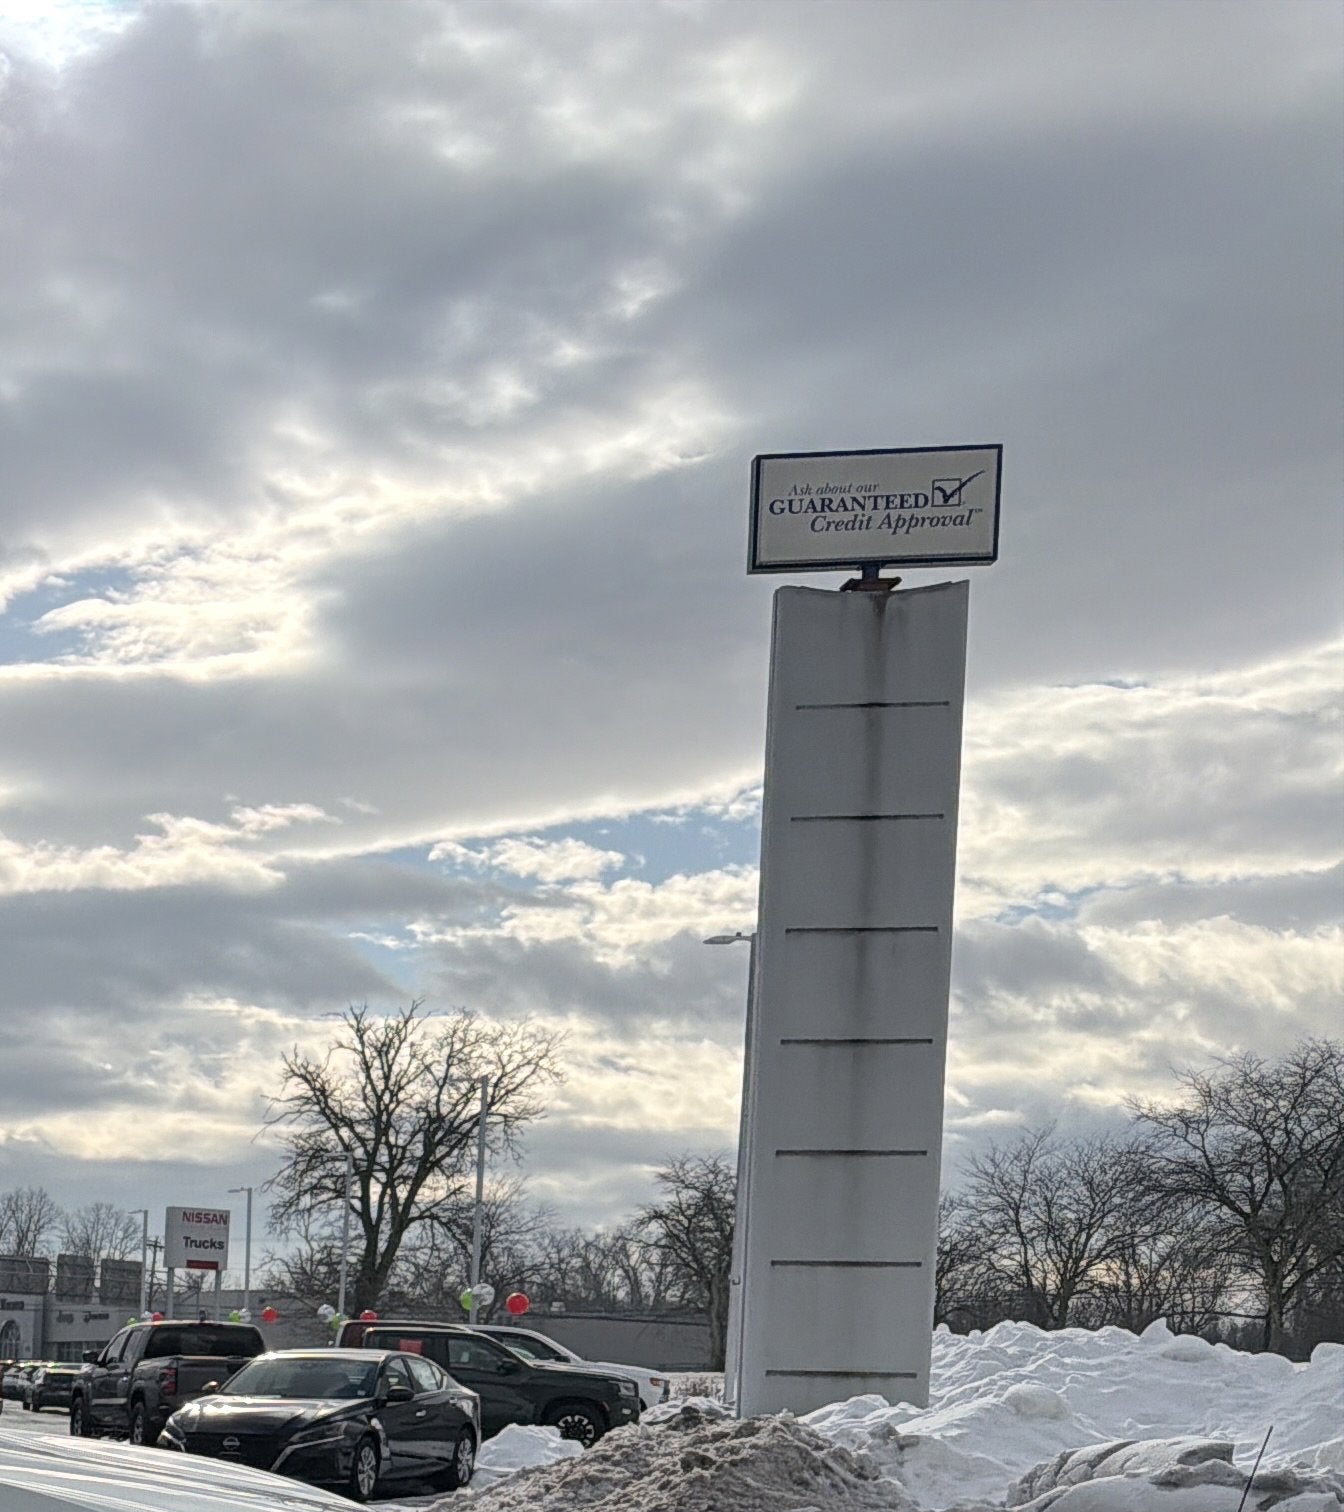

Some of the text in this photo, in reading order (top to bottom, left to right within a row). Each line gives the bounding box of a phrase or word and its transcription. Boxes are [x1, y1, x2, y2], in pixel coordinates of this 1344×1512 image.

[788, 483, 879, 497] Ask about our
[769, 492, 929, 515] GUARANTEED
[810, 508, 974, 535] Credit Approval
[182, 1211, 227, 1225] NISSAN
[182, 1235, 224, 1249] Trucks
